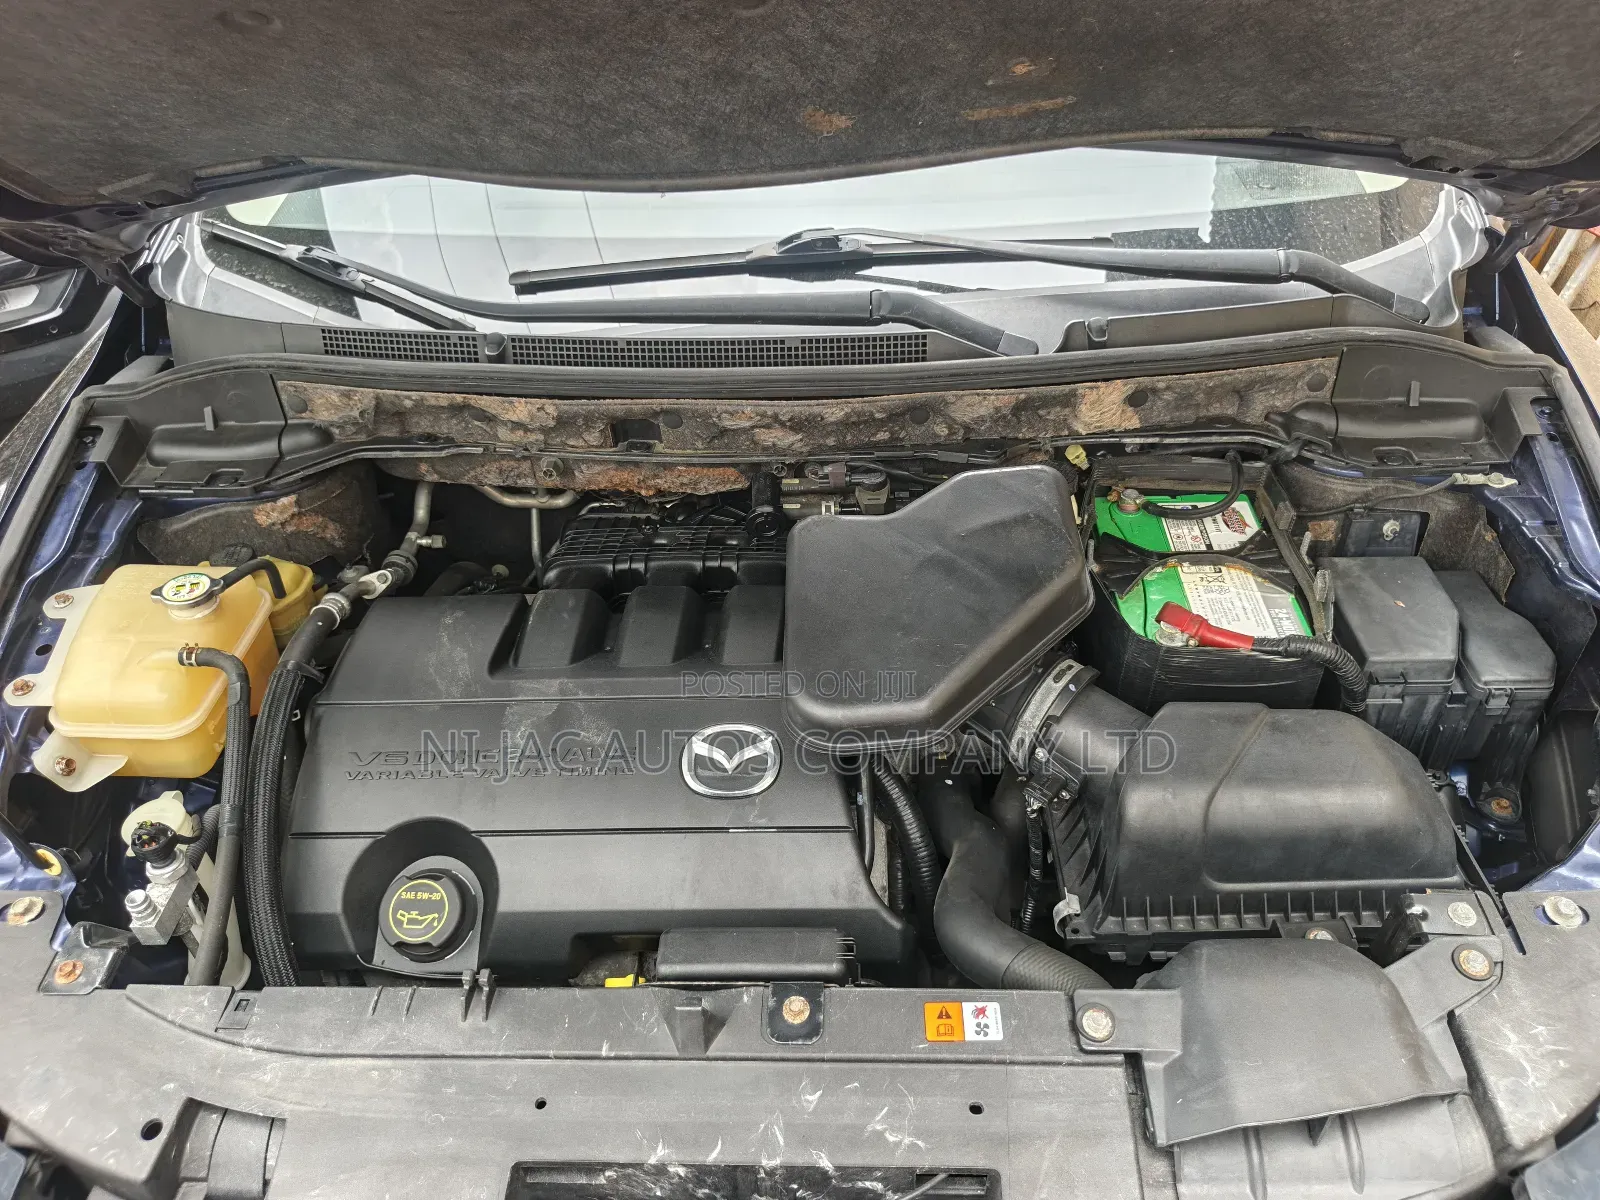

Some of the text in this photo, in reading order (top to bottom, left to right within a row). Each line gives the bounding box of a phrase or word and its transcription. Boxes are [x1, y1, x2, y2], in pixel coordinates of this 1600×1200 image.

[344, 769, 464, 780] VARIABLE
[401, 891, 441, 900] SAE 5W-20
